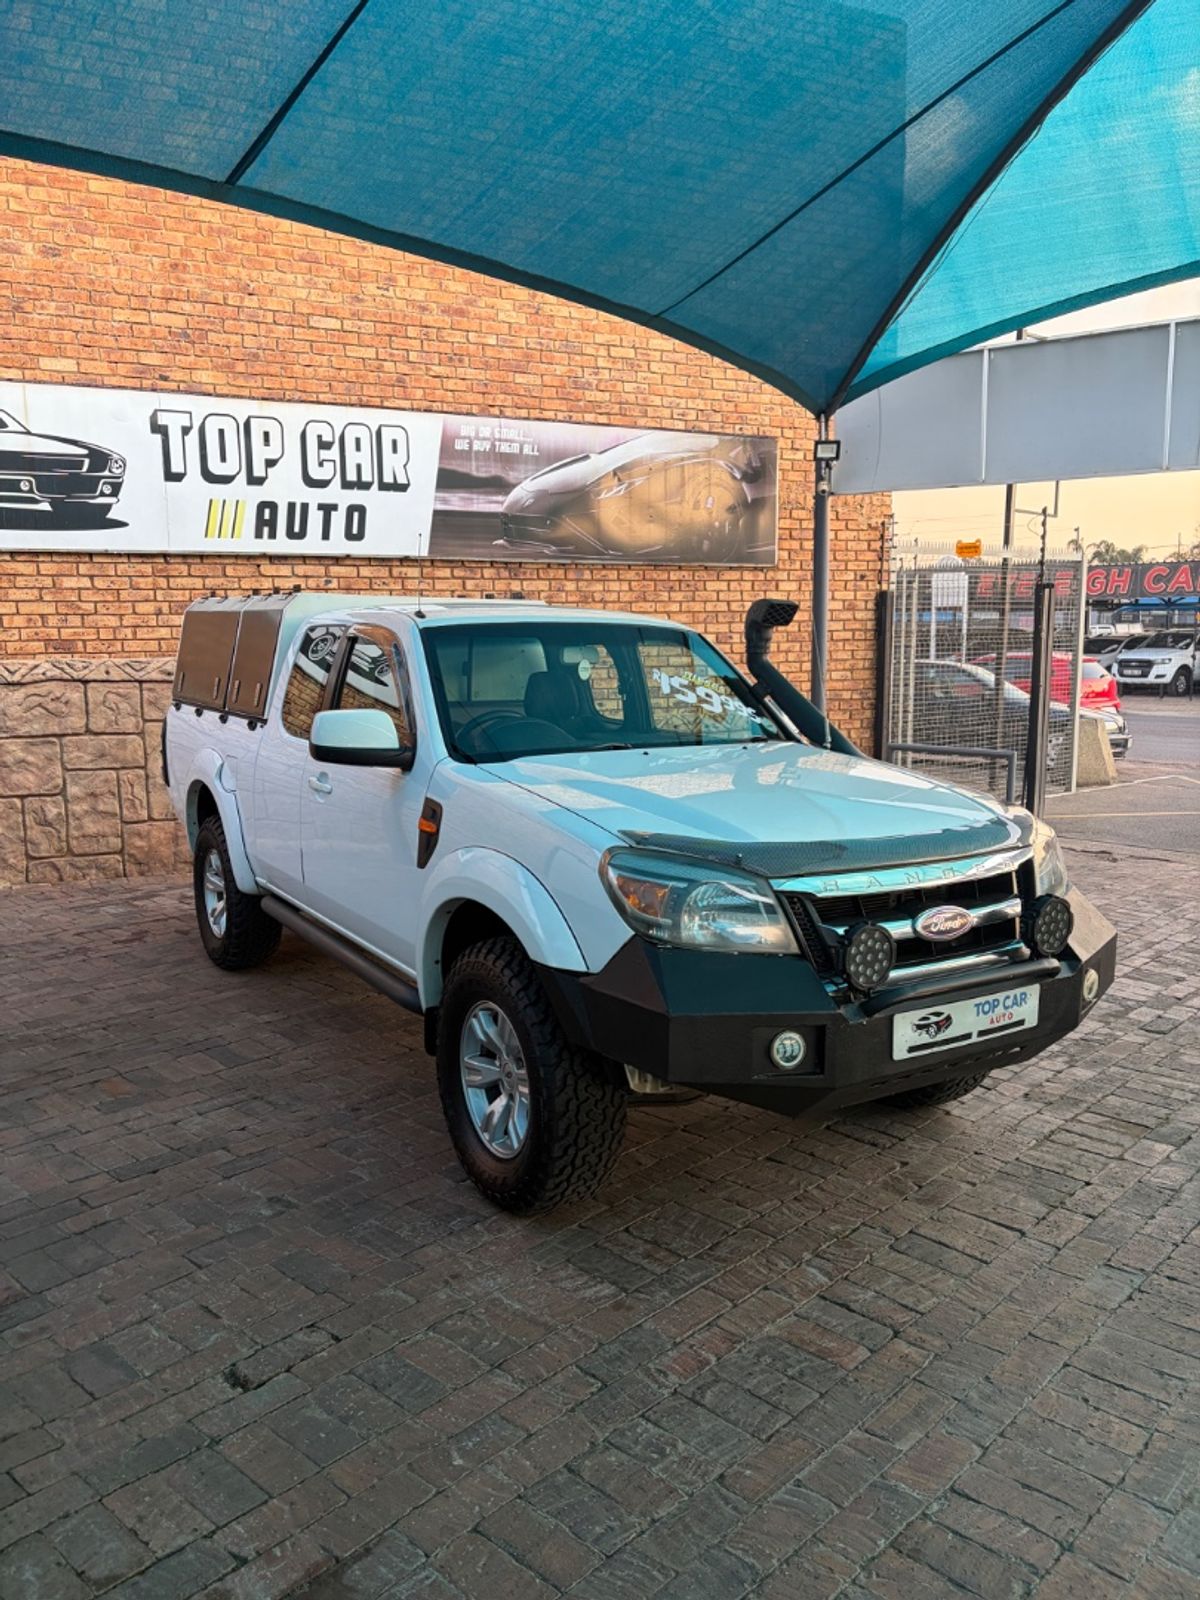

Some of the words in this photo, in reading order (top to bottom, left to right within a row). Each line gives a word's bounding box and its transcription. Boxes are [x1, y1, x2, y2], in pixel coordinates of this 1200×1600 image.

[461, 425, 476, 437] BIG
[479, 427, 491, 438] OR
[150, 409, 284, 486] TOP
[301, 420, 411, 493] CAR
[455, 439, 470, 451] WE
[473, 440, 491, 452] BUY
[495, 441, 520, 455] THEM
[523, 444, 540, 456] ALL
[254, 501, 368, 542] AUTO
[1143, 564, 1200, 594] CA
[930, 914, 966, 932] Ford
[974, 999, 1000, 1017] TOP
[1002, 991, 1028, 1011] CAR
[989, 1012, 1014, 1025] AUTO
